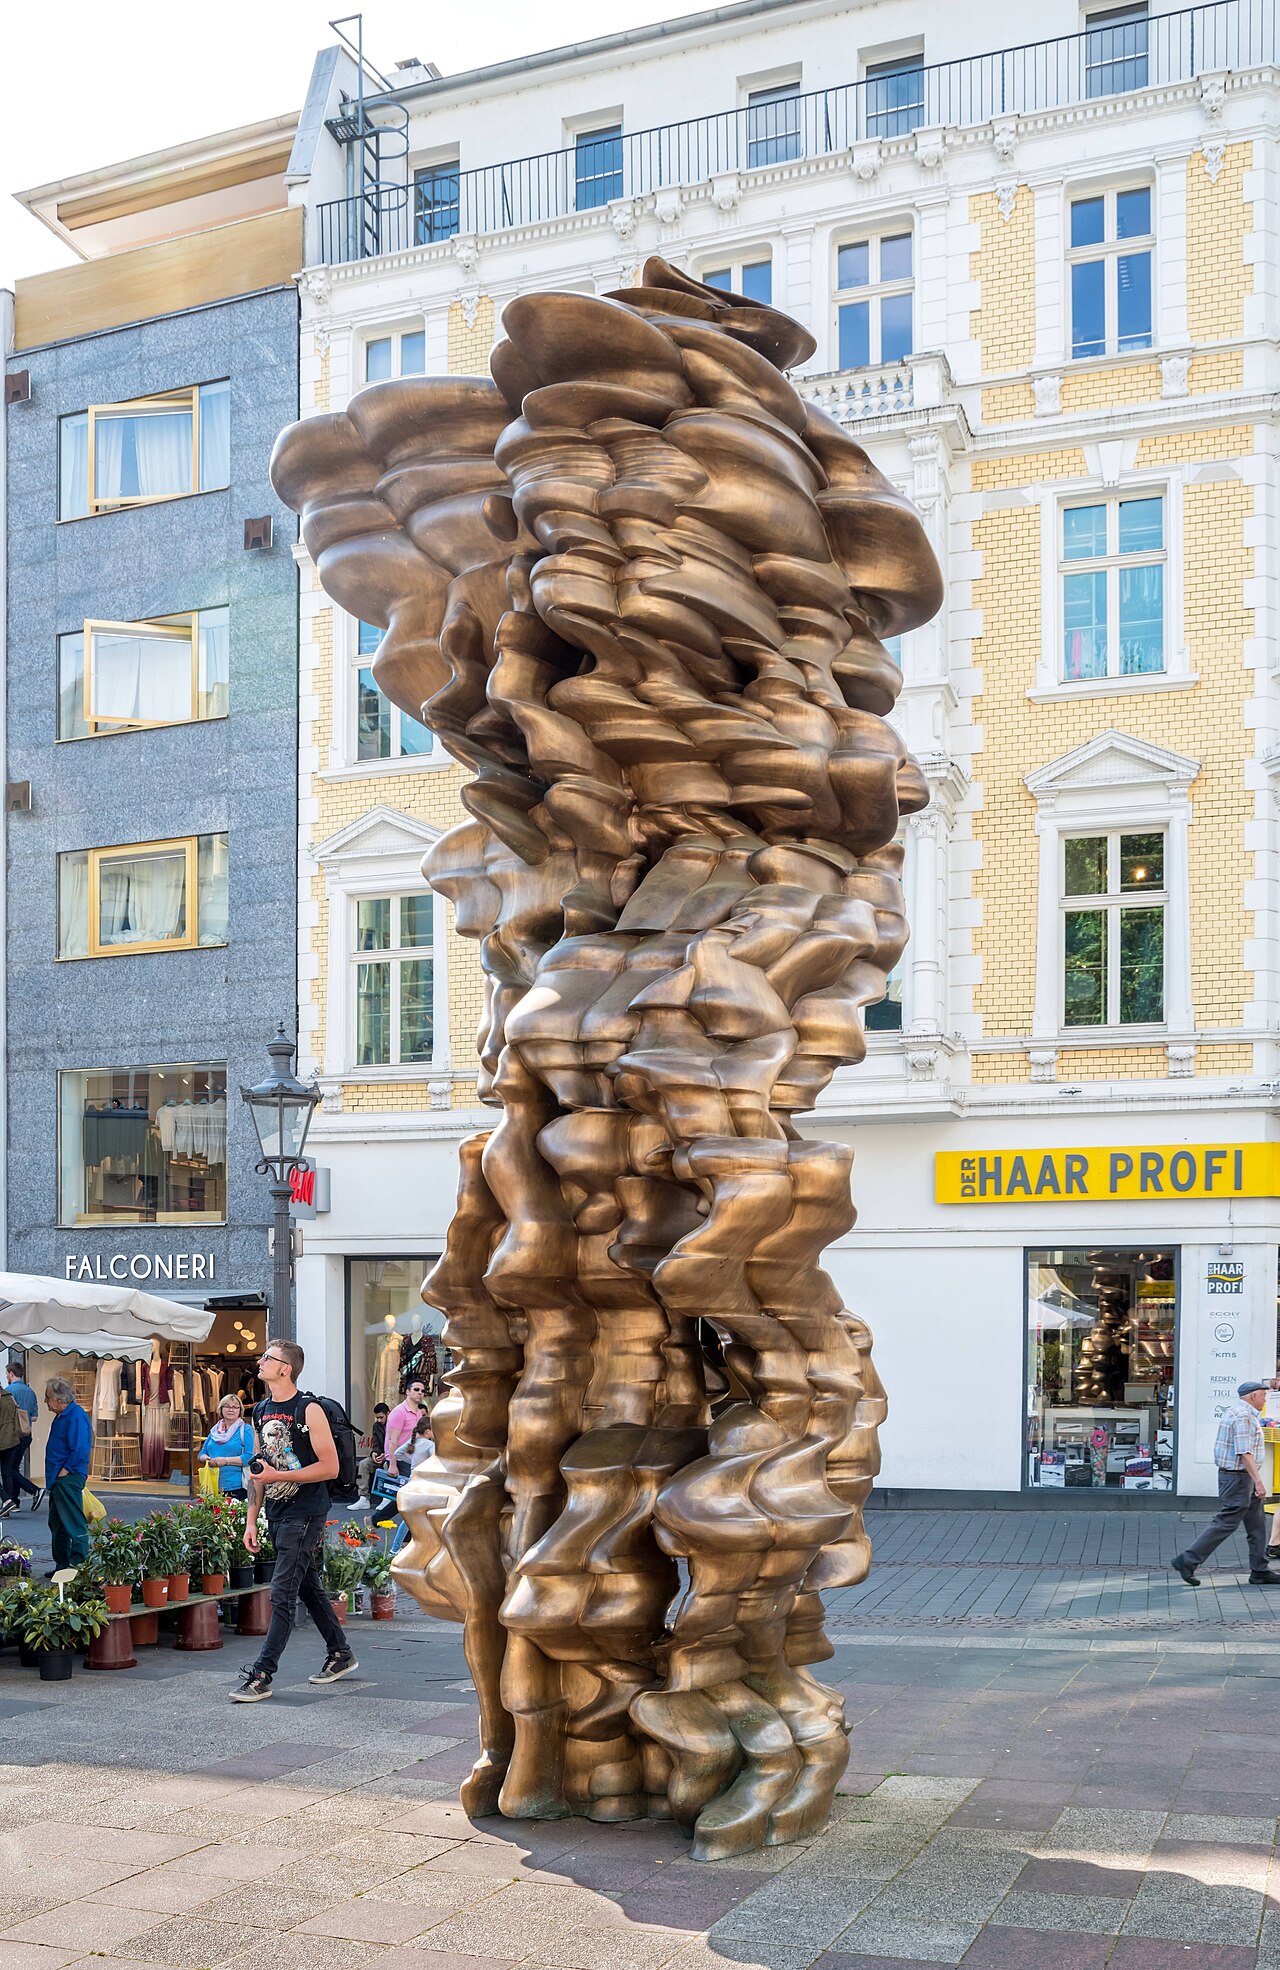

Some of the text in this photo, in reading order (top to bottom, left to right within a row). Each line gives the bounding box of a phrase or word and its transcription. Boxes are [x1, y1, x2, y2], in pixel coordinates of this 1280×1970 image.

[961, 1150, 1242, 1197] DER HAAR PROFI
[65, 1253, 215, 1280] FALCONERI
[1213, 1264, 1243, 1274] HAAR
[1208, 1282, 1243, 1293] PROFI
